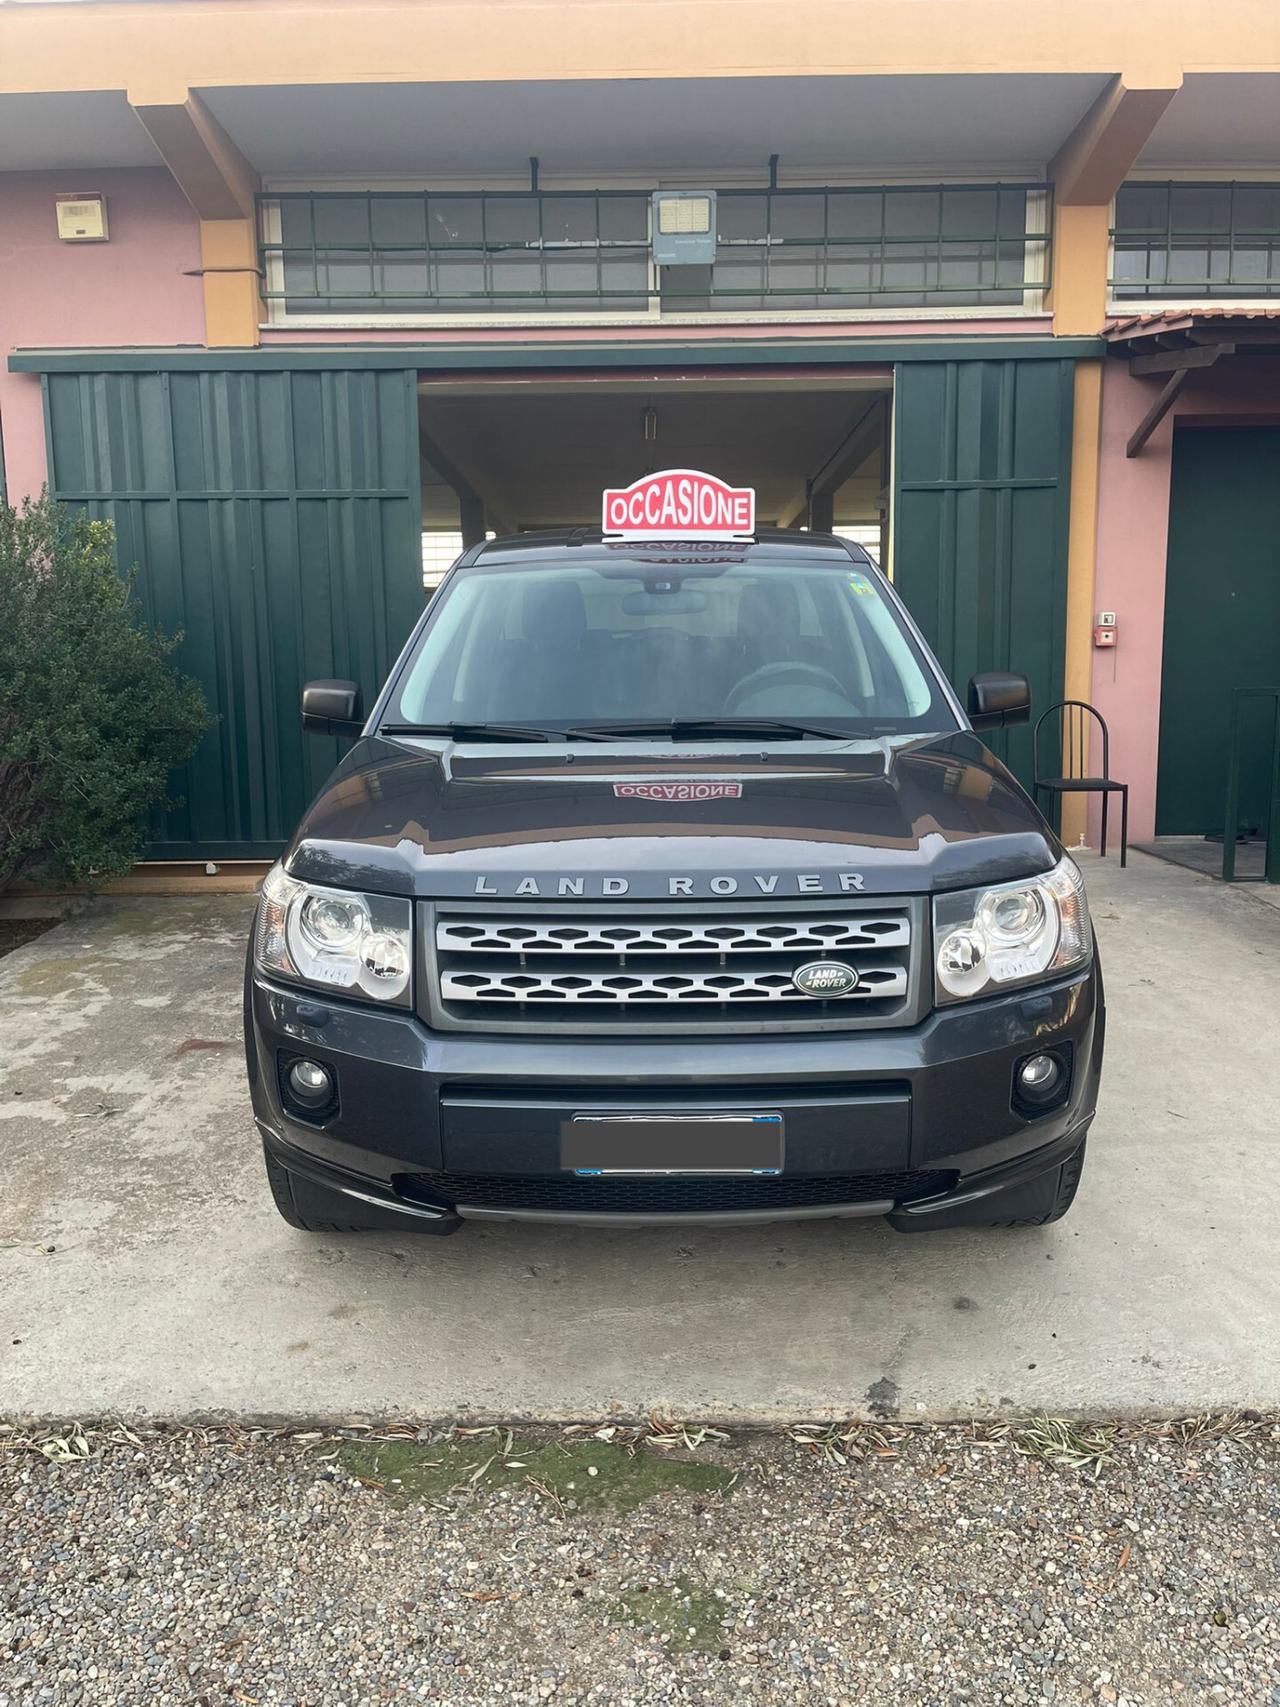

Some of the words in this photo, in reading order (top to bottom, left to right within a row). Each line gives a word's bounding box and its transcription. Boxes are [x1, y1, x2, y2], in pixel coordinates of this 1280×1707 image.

[610, 479, 749, 526] OCCASIONE
[475, 876, 630, 896] LAND
[668, 872, 866, 896] ROVER
[809, 969, 837, 980] LAND
[812, 978, 847, 988] ROVER
